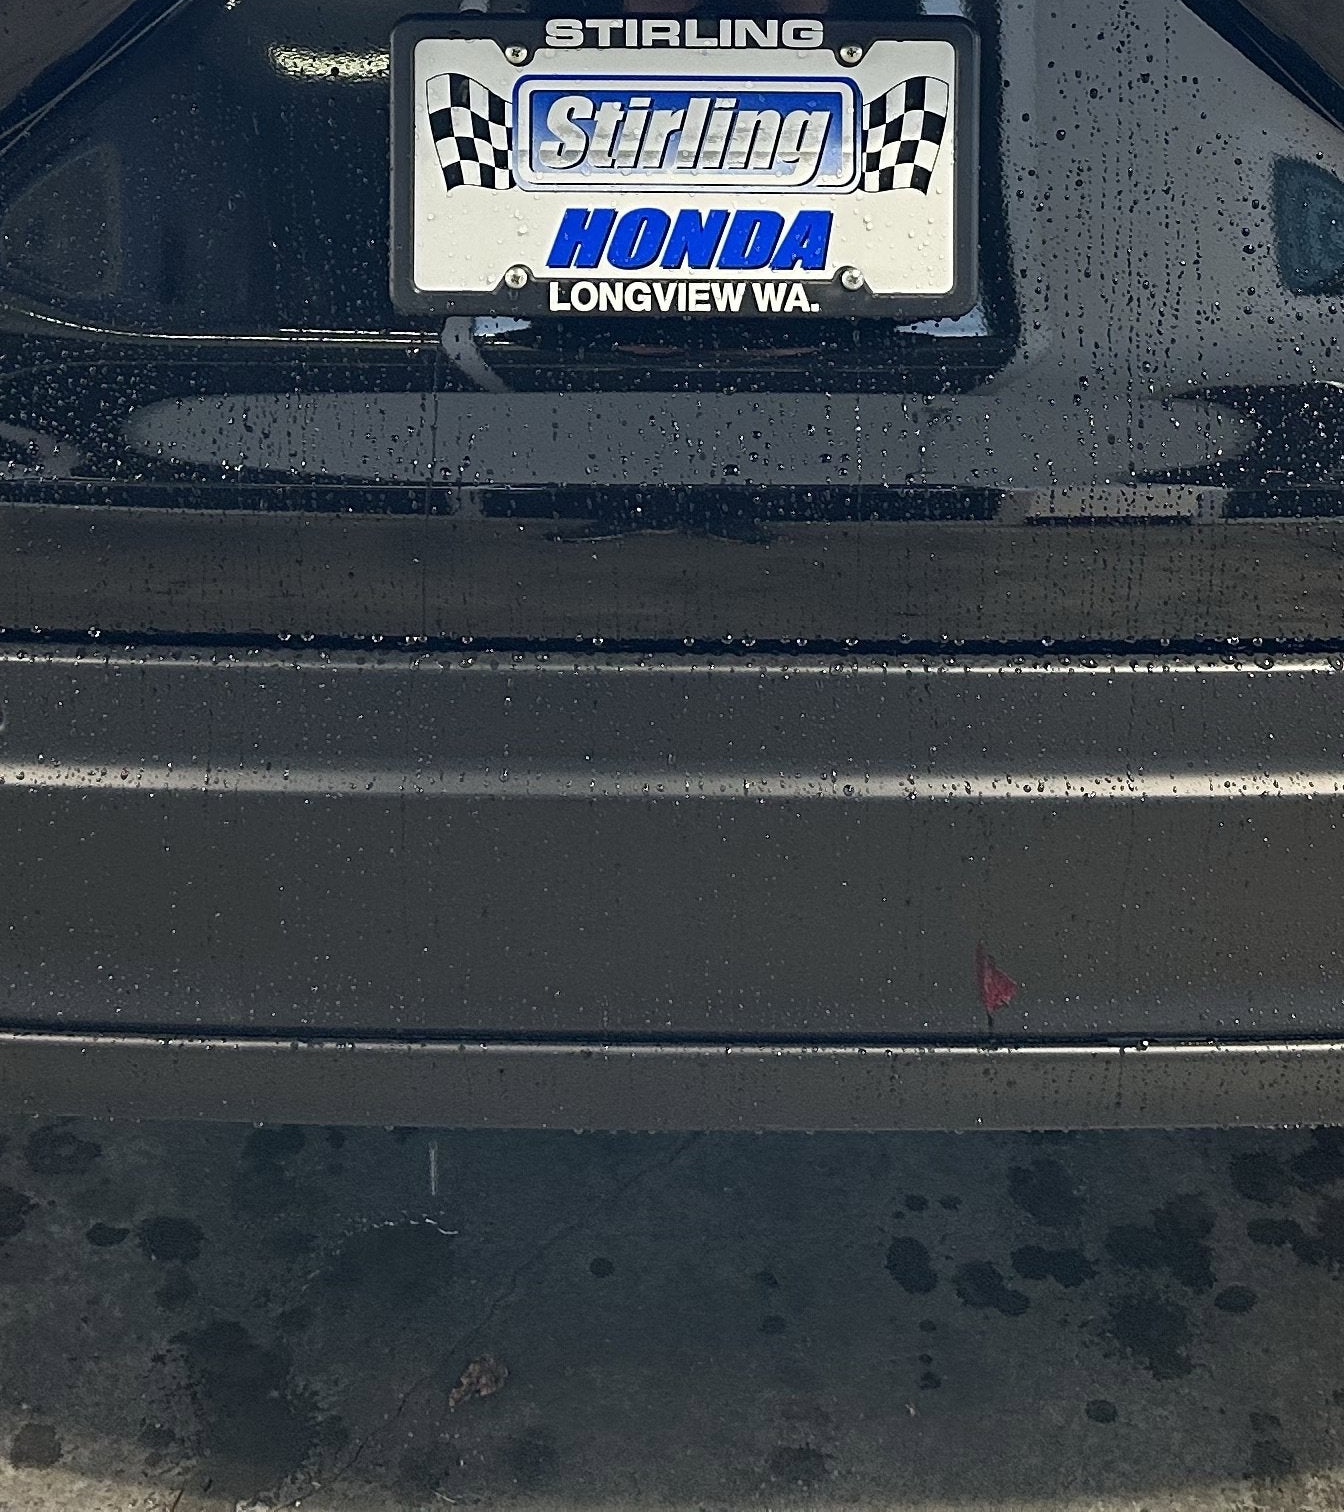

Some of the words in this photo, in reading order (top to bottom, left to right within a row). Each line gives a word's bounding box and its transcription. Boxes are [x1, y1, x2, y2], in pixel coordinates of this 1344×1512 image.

[545, 18, 824, 47] STIRLING
[538, 95, 831, 185] Stirling
[546, 207, 833, 270] HONDA
[549, 281, 746, 312] LONGVIEW
[752, 282, 820, 312] WA.
